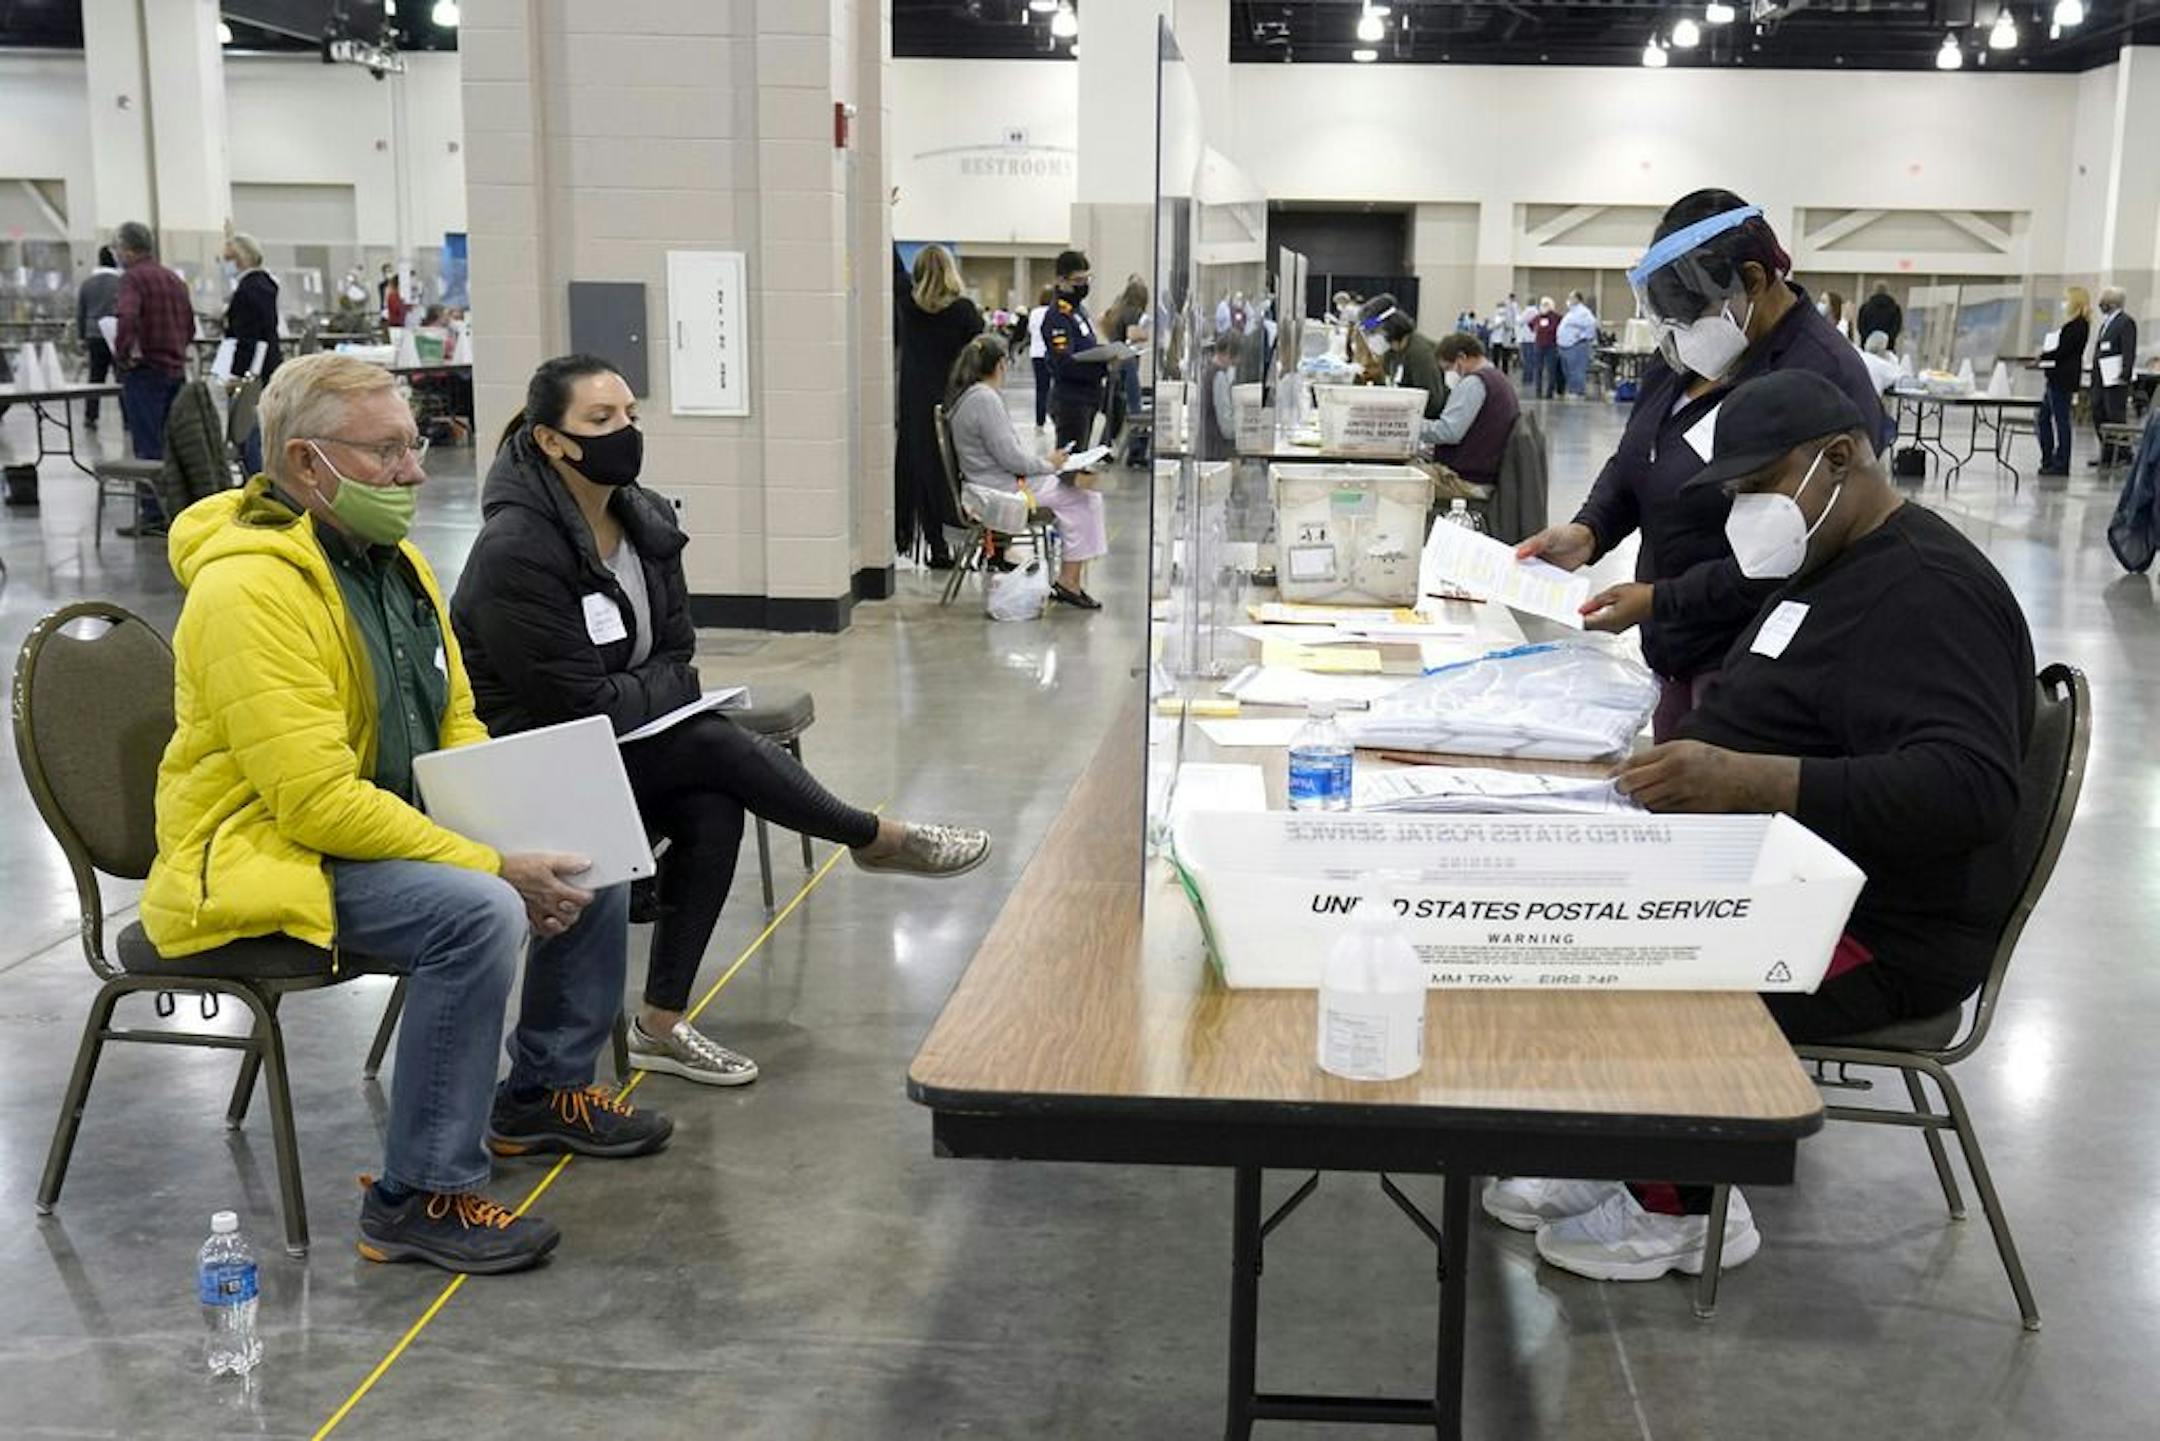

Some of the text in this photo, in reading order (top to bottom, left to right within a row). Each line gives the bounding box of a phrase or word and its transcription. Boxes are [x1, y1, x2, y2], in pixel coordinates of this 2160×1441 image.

[960, 157, 1073, 176] RESTROOMS
[1312, 894, 1752, 921] UNID STATES POSTAL SERVICE
[1487, 933, 1575, 945] WARNING
[1468, 973, 1513, 984] TRAY
